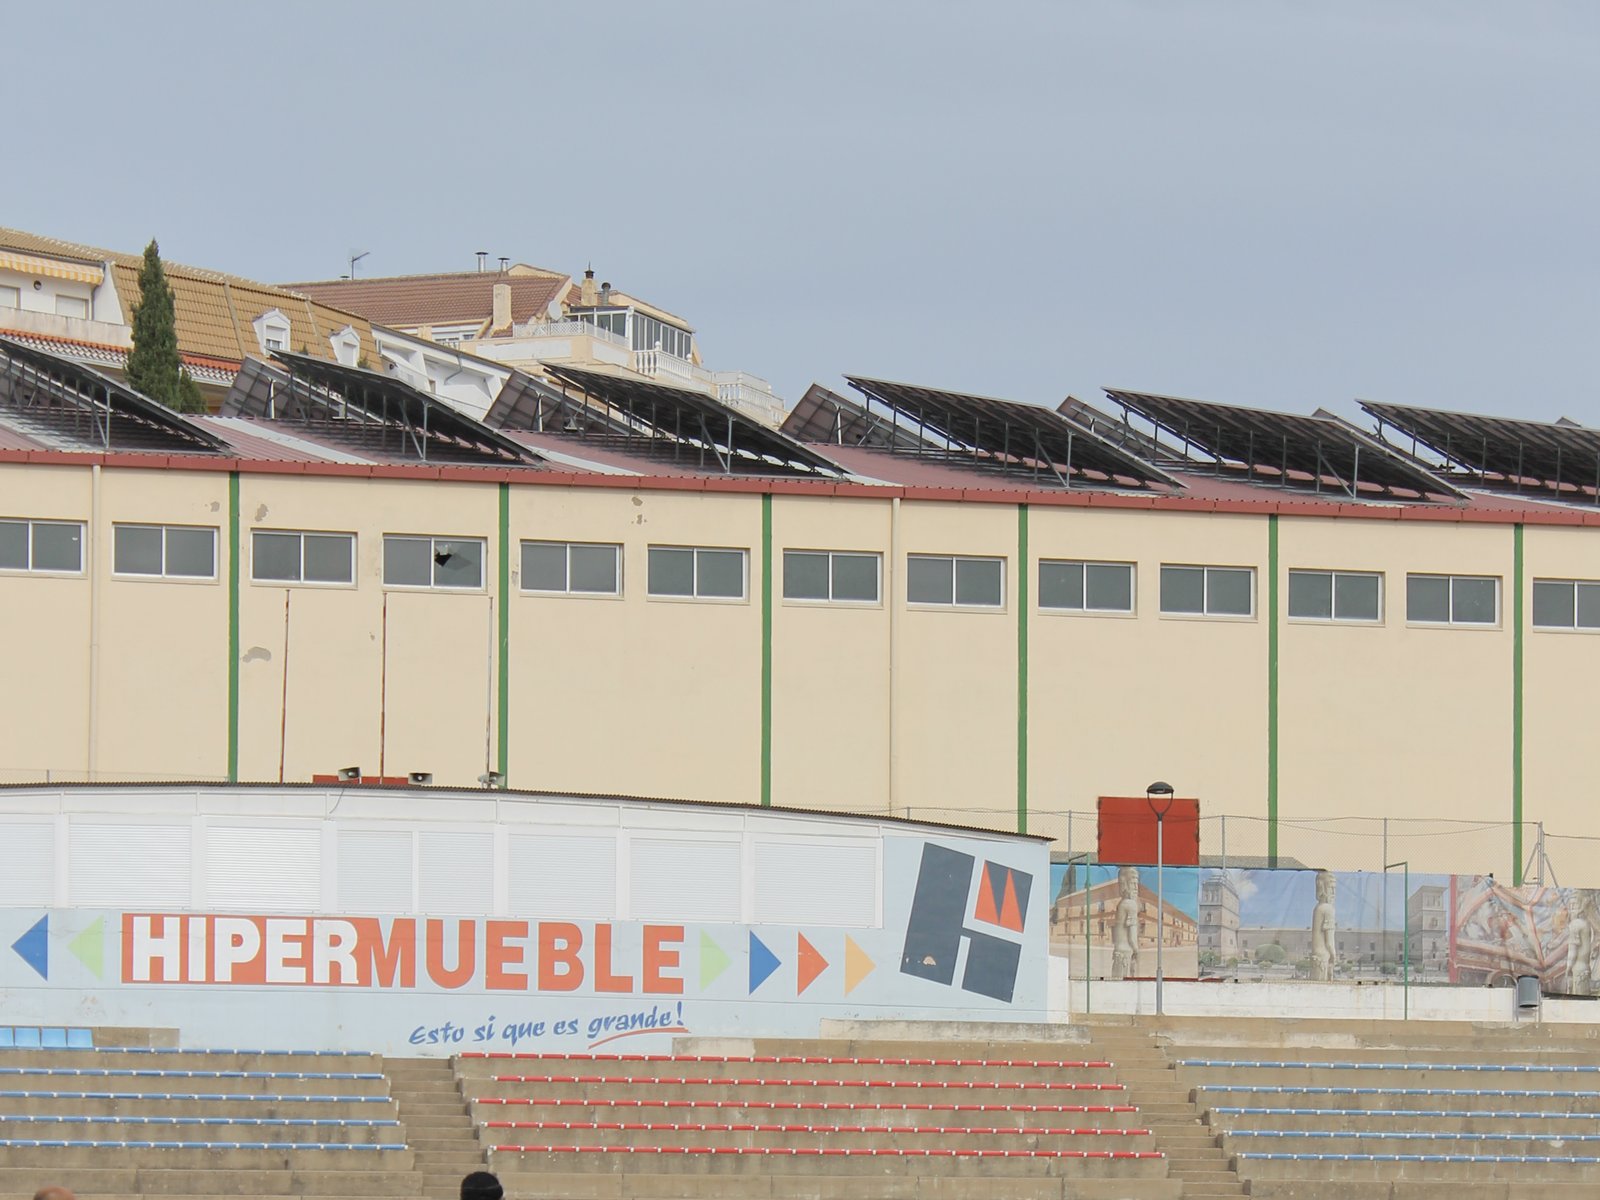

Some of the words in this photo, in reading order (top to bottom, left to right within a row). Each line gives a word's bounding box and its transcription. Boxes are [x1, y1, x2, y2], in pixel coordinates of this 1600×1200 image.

[130, 915, 685, 994] HIPERMUEBLE
[408, 1022, 464, 1045] Esto
[502, 1020, 546, 1047] que
[553, 1017, 579, 1036] es
[587, 1001, 685, 1039] grande!
